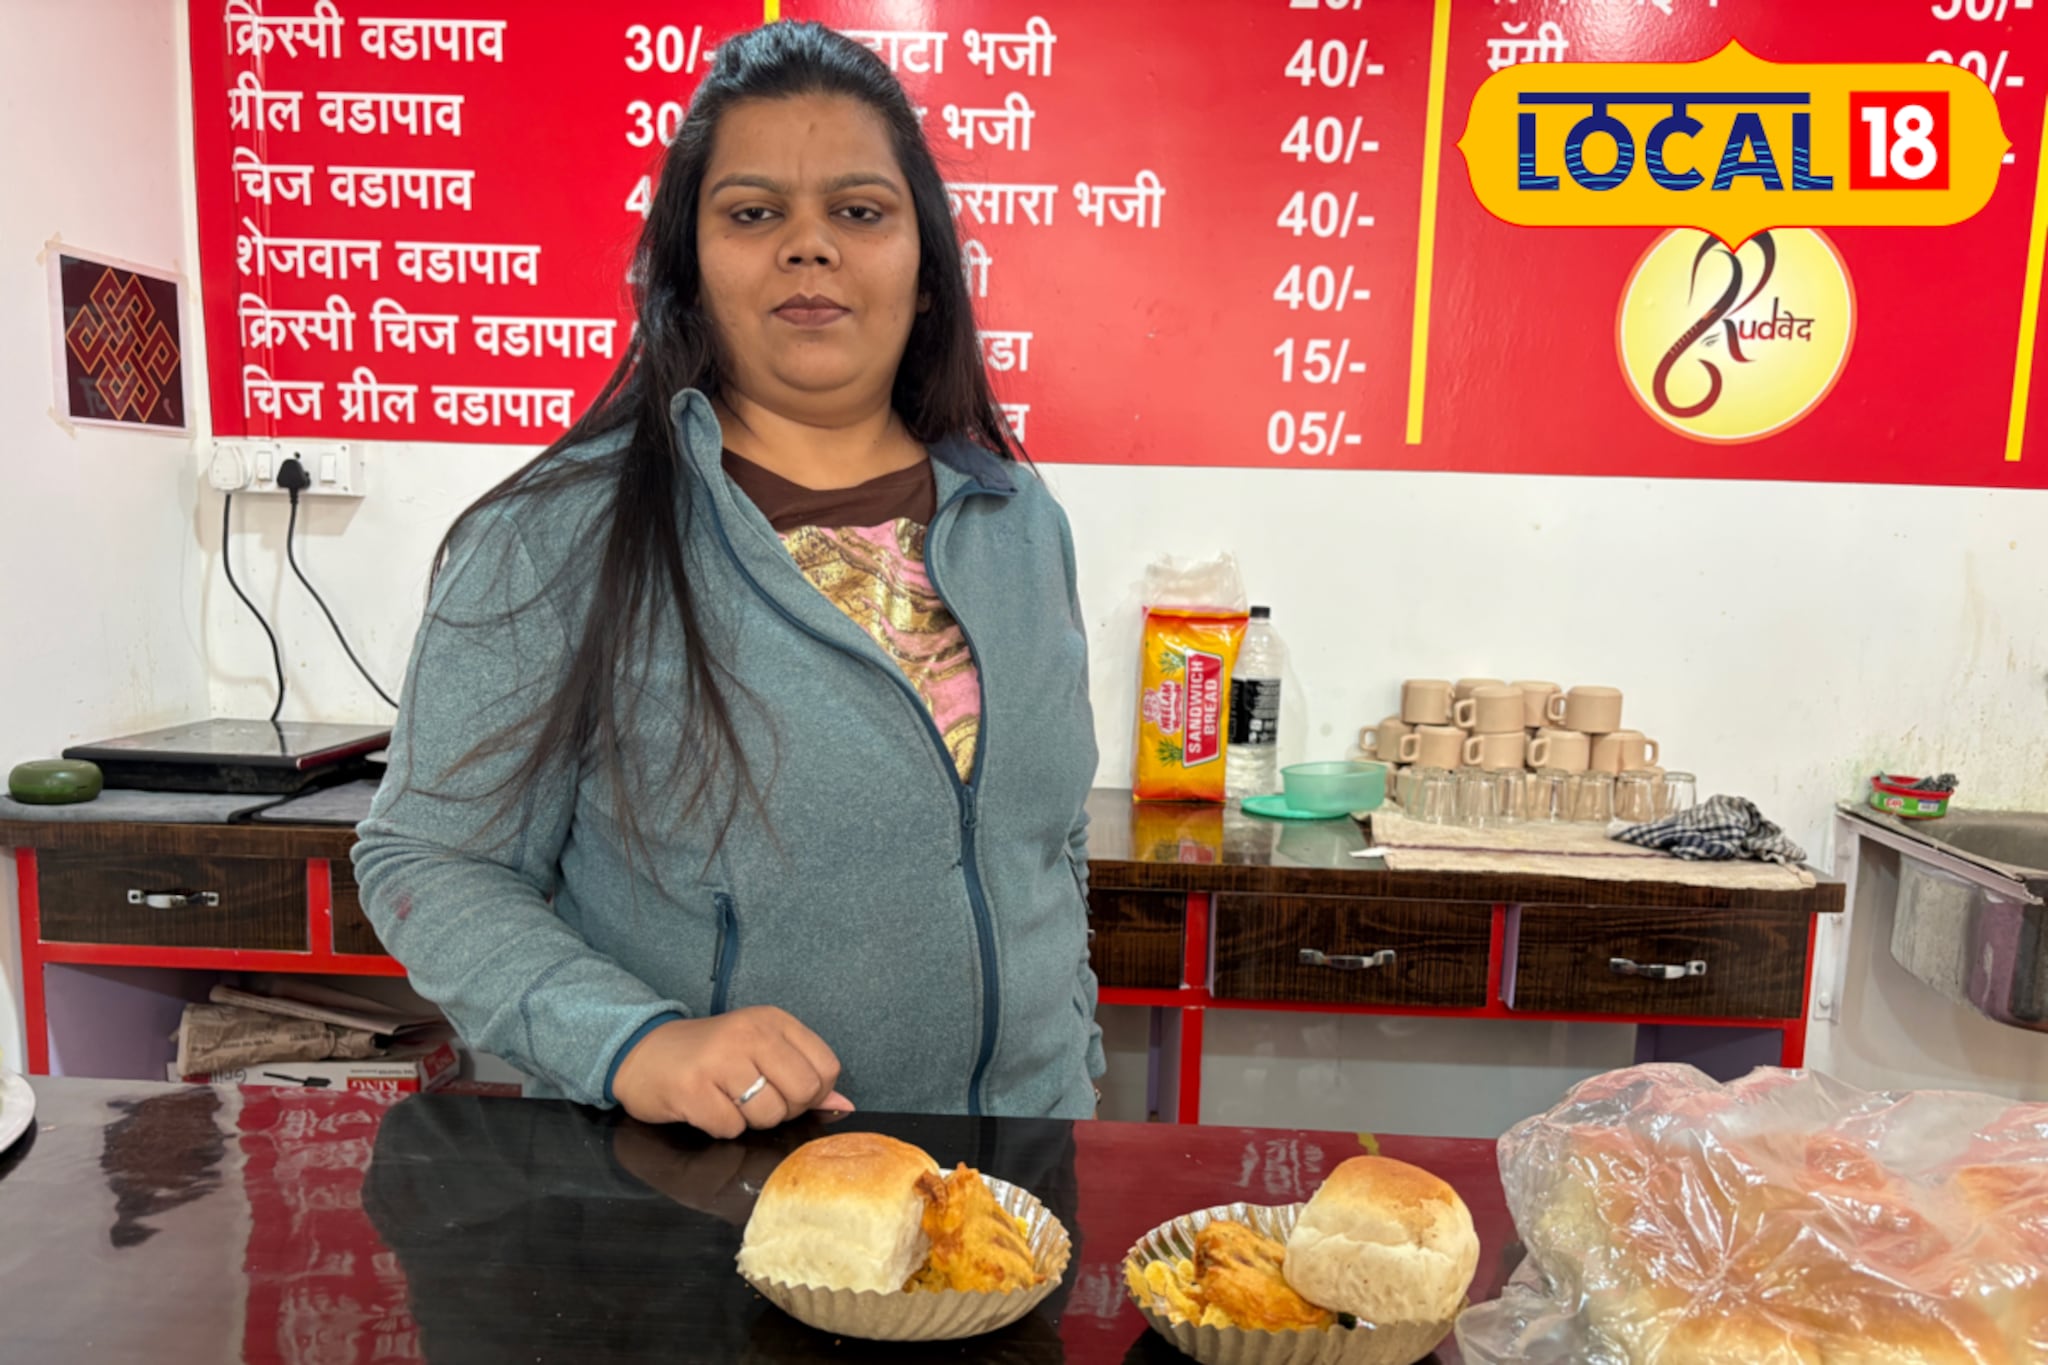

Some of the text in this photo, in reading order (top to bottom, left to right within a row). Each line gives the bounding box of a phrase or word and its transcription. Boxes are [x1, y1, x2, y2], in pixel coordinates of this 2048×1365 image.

[224, 0, 718, 74] क्रिस्पी वडापाव 30/-
[963, 16, 1056, 77] भजी
[1285, 39, 1384, 88] 40/-
[228, 71, 303, 132] ग्रील
[317, 92, 464, 136] वडापाव
[943, 91, 1379, 163] भजी 40/-
[232, 147, 474, 210] चिज वडापाव
[1073, 170, 1165, 228] भजी
[1277, 191, 1375, 238] 40/-
[236, 217, 541, 286] शेजवान वडापाव
[1273, 265, 1371, 311] 40/-
[238, 293, 355, 351] क्रिस्पी
[370, 298, 459, 354] चिज
[473, 316, 616, 359] वडापाव
[976, 330, 1366, 383] डा 15/-
[243, 364, 575, 428] चिज ग्रील वडापाव
[1267, 411, 1362, 456] 05/-
[1188, 660, 1204, 754] SANDWICH
[1204, 679, 1218, 736] BREAD
